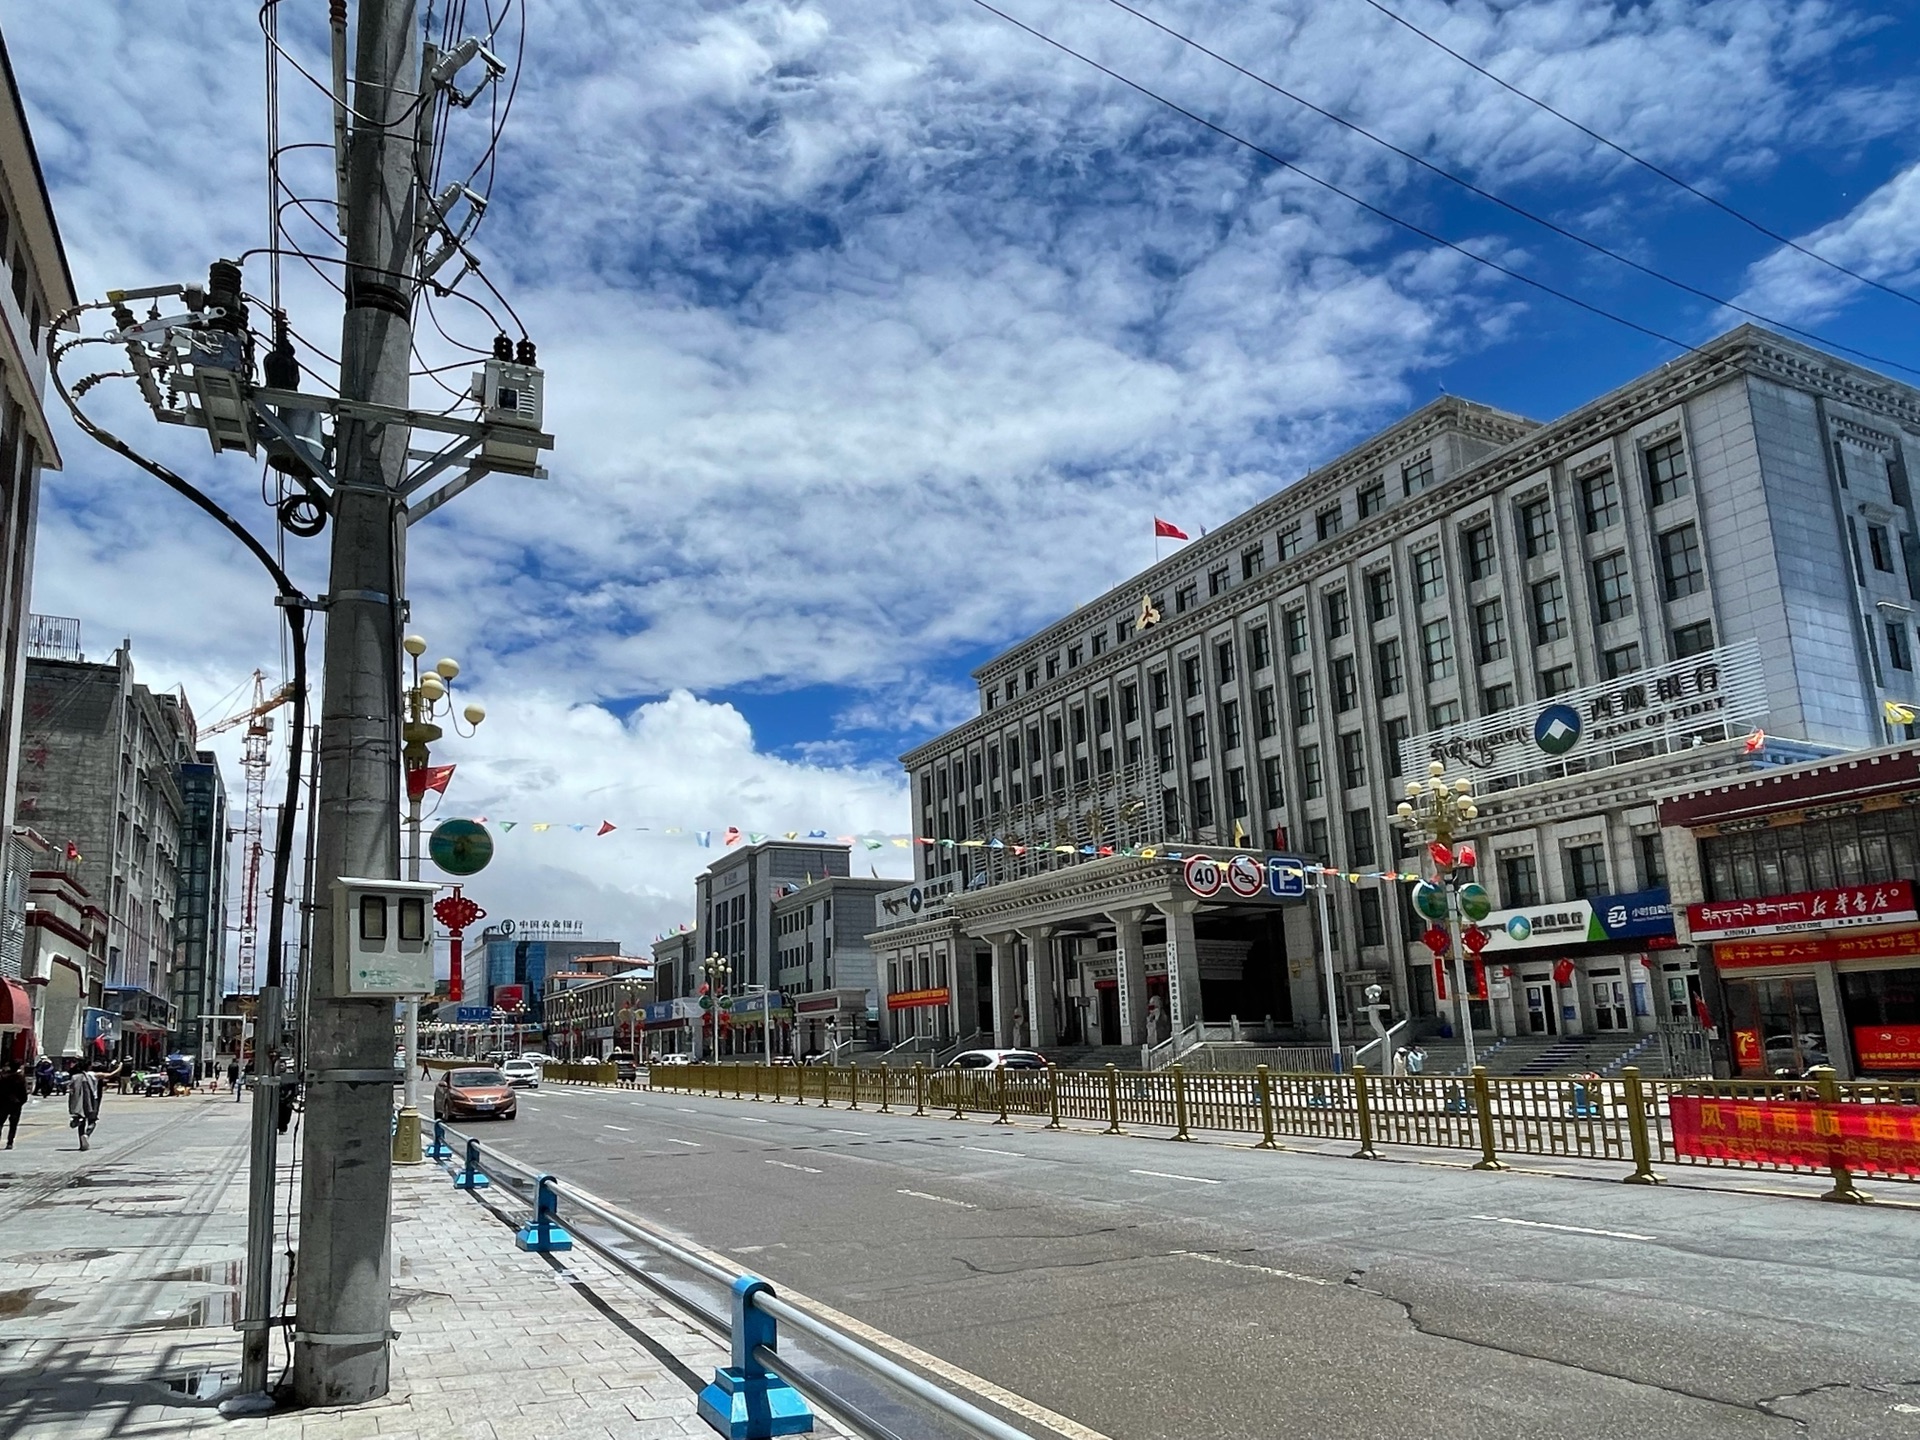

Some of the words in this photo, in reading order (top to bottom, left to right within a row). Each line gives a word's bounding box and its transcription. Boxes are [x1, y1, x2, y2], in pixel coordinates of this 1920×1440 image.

[1592, 719, 1642, 740] BANK
[1645, 711, 1667, 726] OF
[1669, 696, 1726, 720] TIBET
[1194, 867, 1215, 885] 40
[519, 919, 583, 930] 中国农业银行
[1608, 909, 1628, 925] 24
[1724, 928, 1757, 937] XINHUA
[1776, 921, 1823, 933] BOOKSTORE
[1837, 931, 1920, 951] 知识创造
